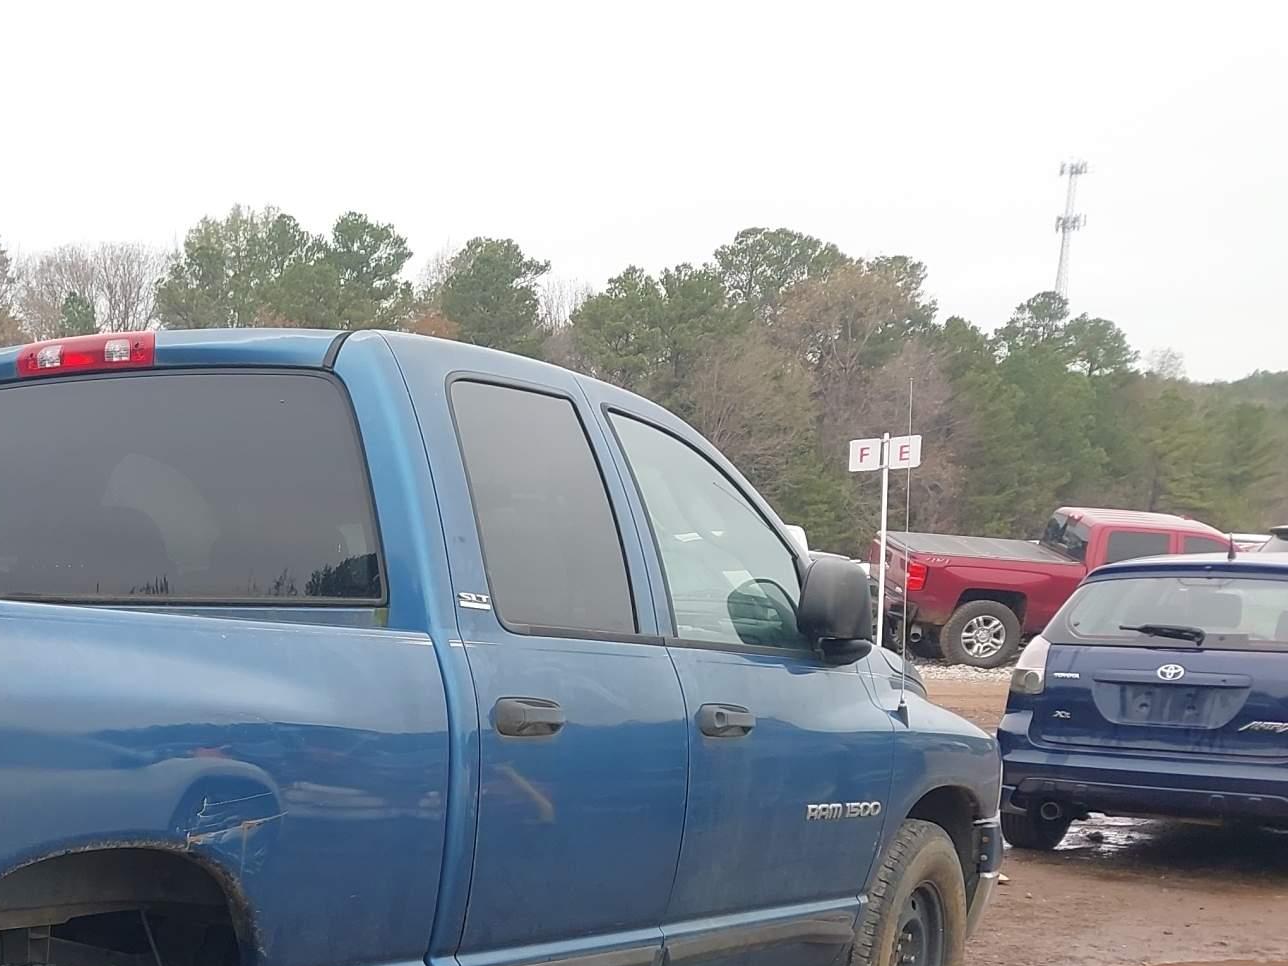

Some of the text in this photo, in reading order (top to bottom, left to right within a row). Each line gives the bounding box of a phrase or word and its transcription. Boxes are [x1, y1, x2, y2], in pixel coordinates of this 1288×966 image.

[859, 446, 871, 463] F
[899, 444, 911, 461] E
[807, 801, 881, 820] RAM 1500
